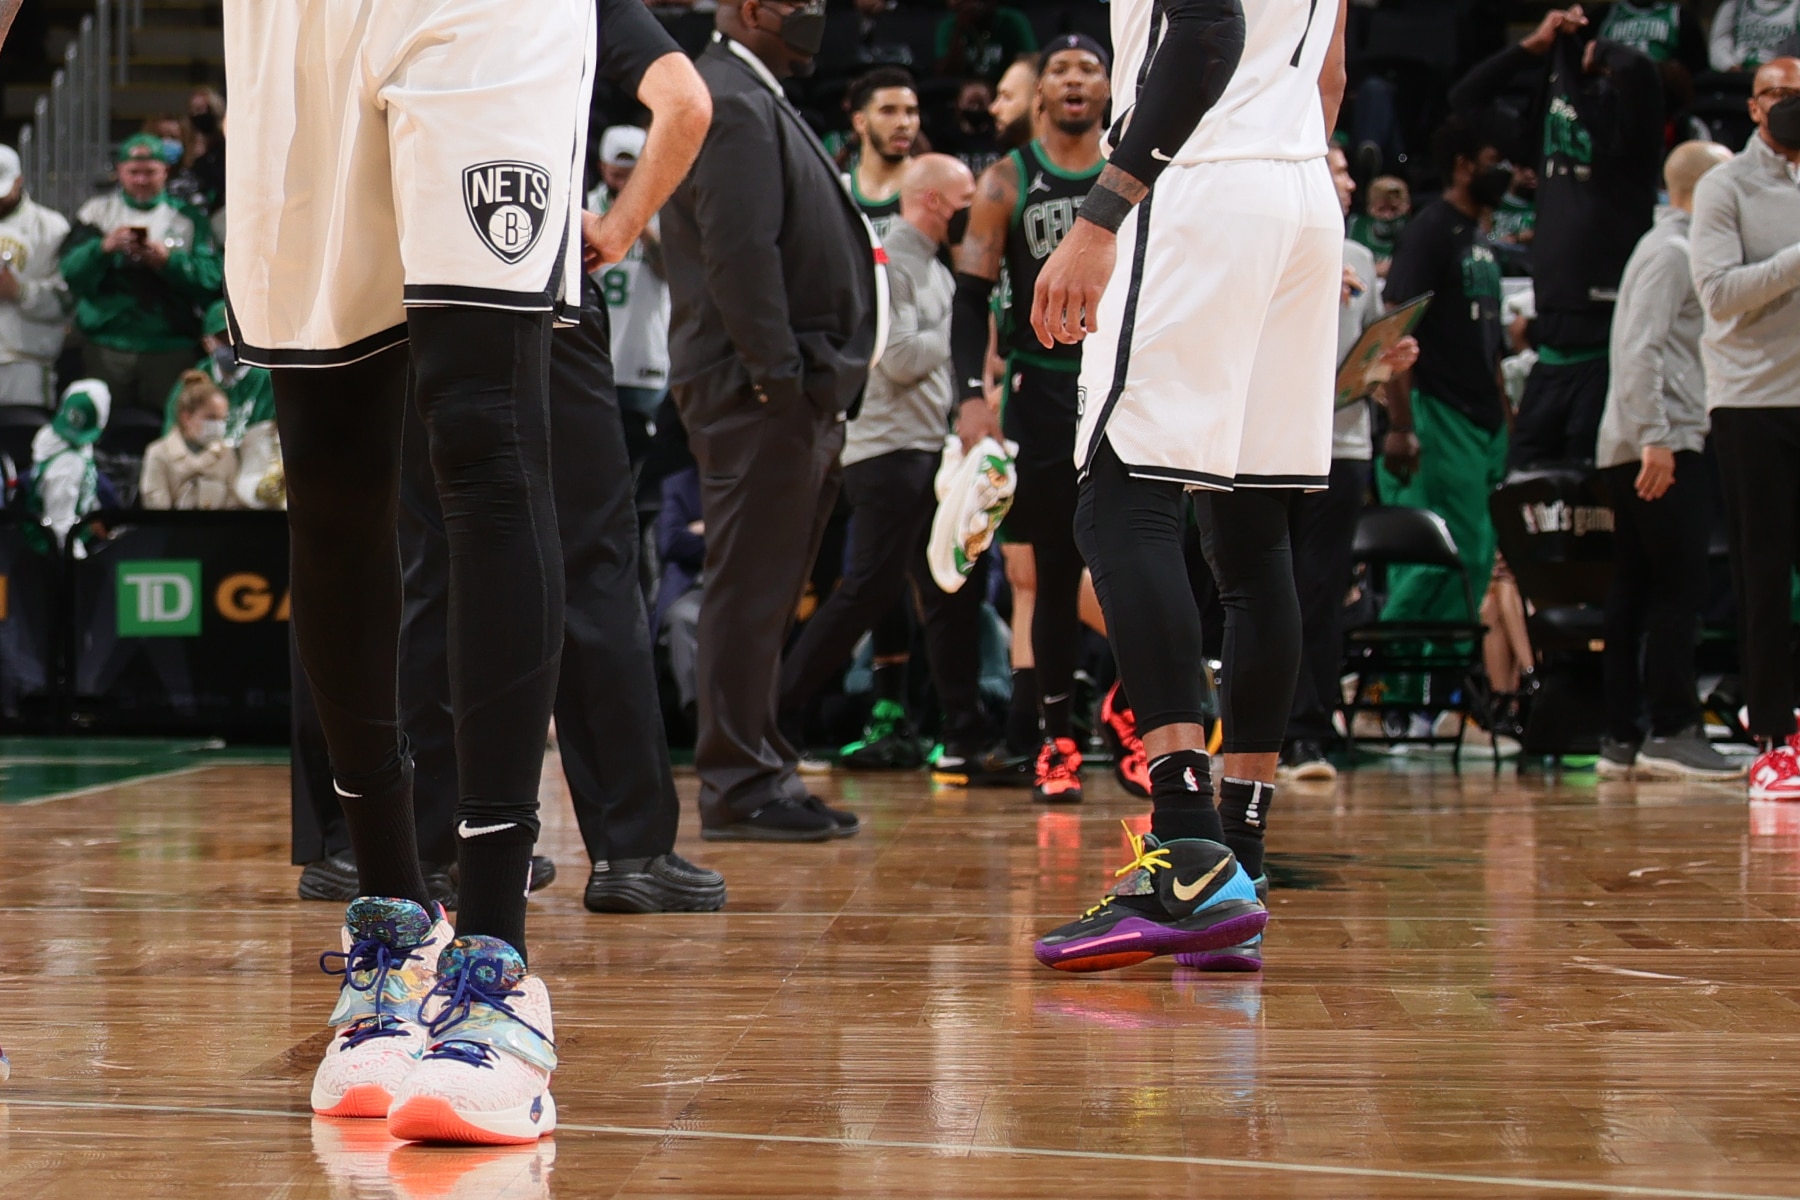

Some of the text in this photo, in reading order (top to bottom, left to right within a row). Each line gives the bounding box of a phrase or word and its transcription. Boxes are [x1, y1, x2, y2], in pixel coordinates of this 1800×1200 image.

[472, 166, 548, 210] NETS
[505, 212, 518, 246] B
[123, 574, 195, 622] TD
